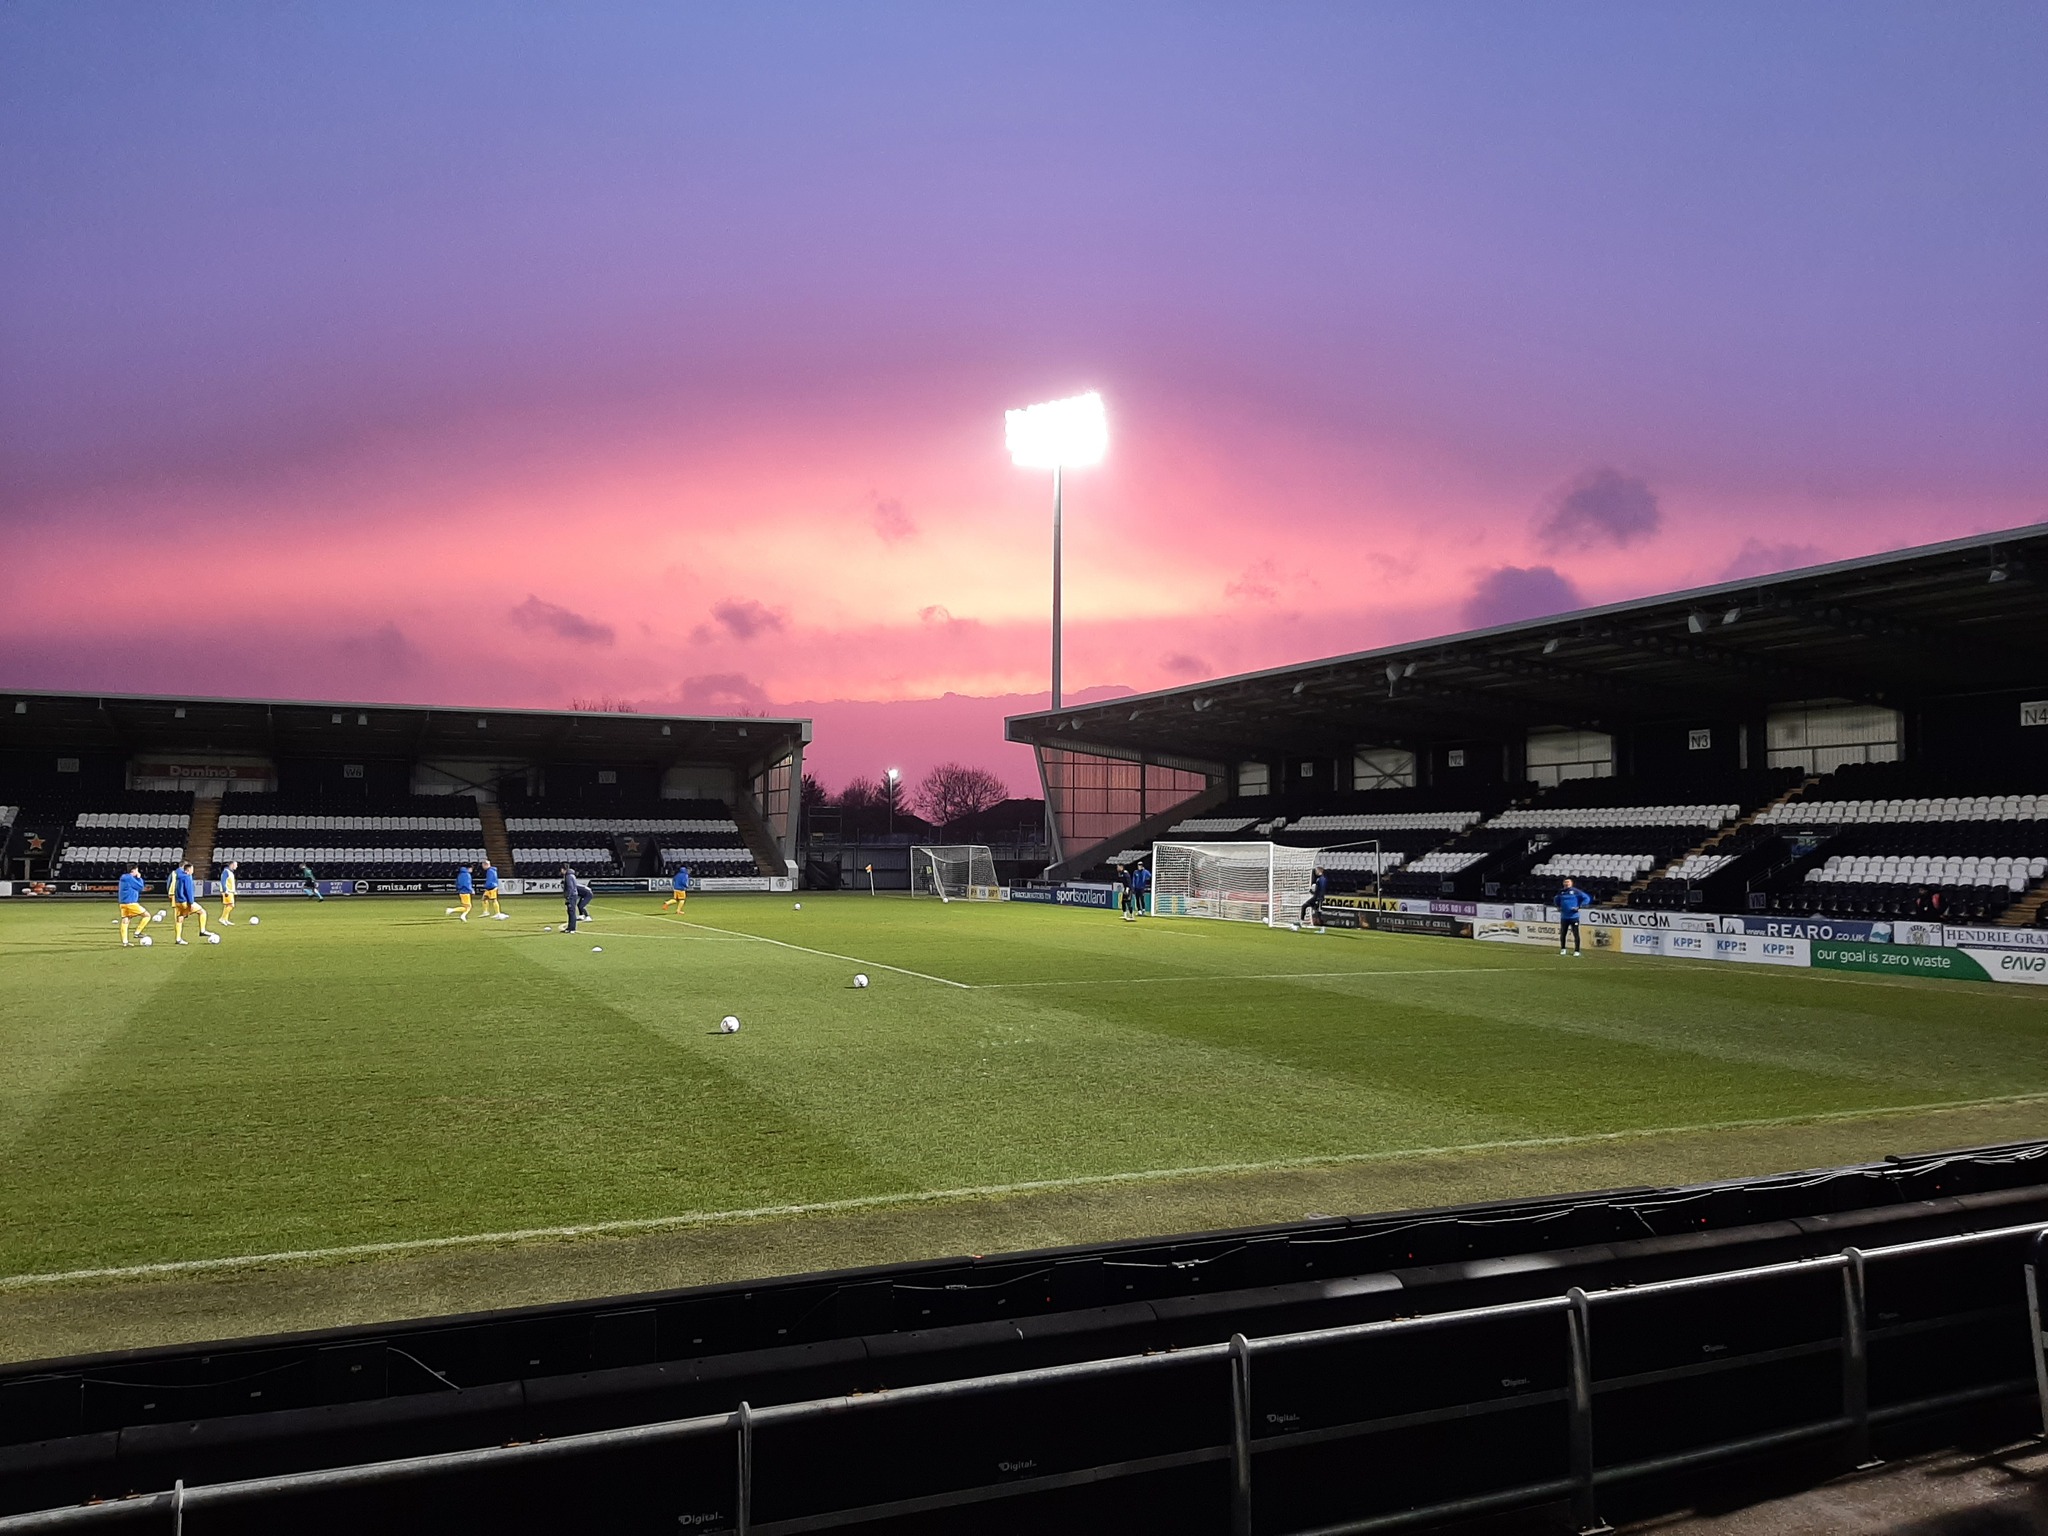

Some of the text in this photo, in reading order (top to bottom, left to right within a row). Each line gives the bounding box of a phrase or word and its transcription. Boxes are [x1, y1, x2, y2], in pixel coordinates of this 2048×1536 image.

[2025, 709, 2048, 724] N4
[1691, 735, 1708, 748] N3
[169, 765, 237, 778] Domino's
[1056, 888, 1106, 905] sportscotland
[1767, 923, 1833, 940] REARO
[1947, 929, 2009, 943] HENDRIE
[1633, 934, 1651, 945] KPP
[1674, 937, 1693, 948] KPP
[1717, 940, 1738, 951] KPP
[1763, 943, 1785, 955] KPP
[1817, 949, 1950, 968] our goal is zero waste
[2001, 955, 2046, 972] enva
[678, 1511, 718, 1525] Digital
